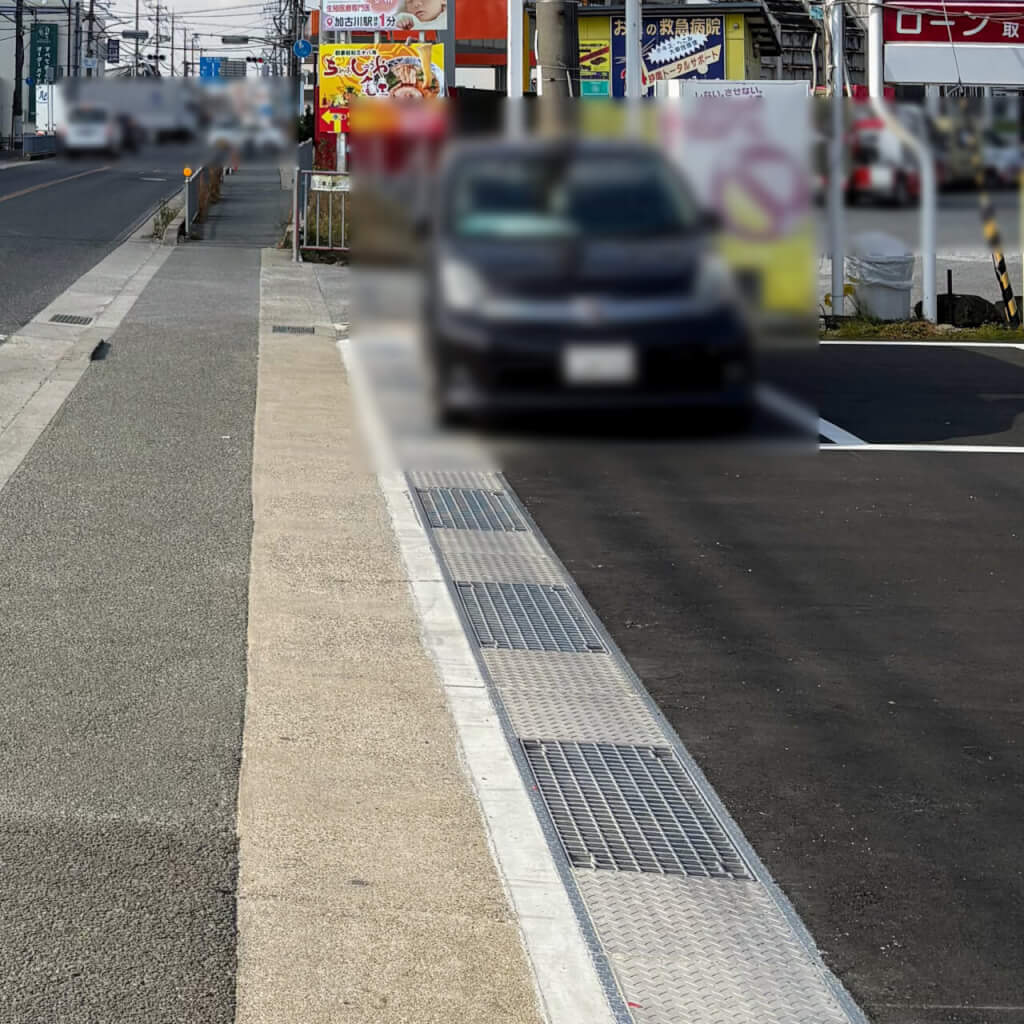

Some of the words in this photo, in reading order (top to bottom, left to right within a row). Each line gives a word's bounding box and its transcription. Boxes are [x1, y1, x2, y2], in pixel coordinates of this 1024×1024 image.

[613, 18, 721, 36] おの救急病院
